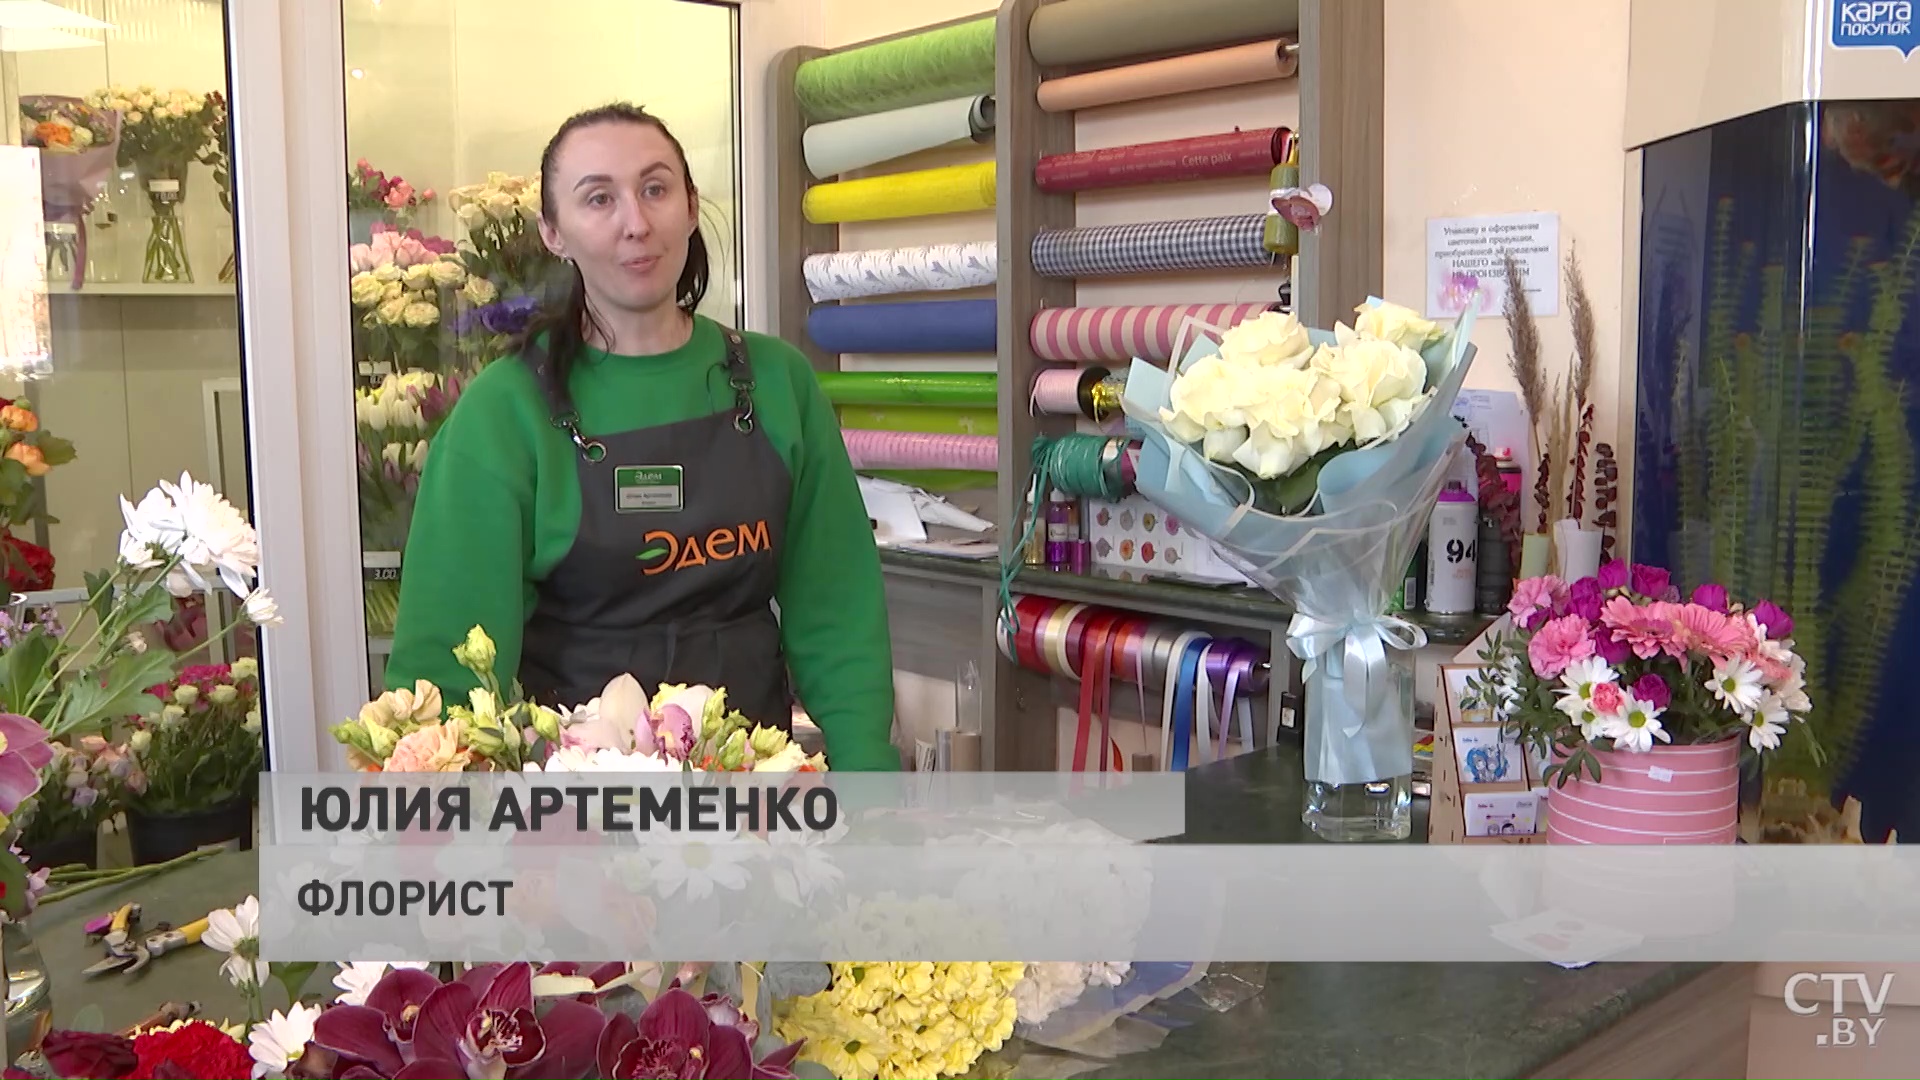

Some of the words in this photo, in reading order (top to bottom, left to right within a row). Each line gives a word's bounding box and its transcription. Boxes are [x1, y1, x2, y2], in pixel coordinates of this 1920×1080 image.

[1182, 155, 1209, 167] Cette
[1211, 152, 1232, 166] paix
[1452, 259, 1489, 268] НАШЕГО
[1446, 538, 1477, 563] 94
